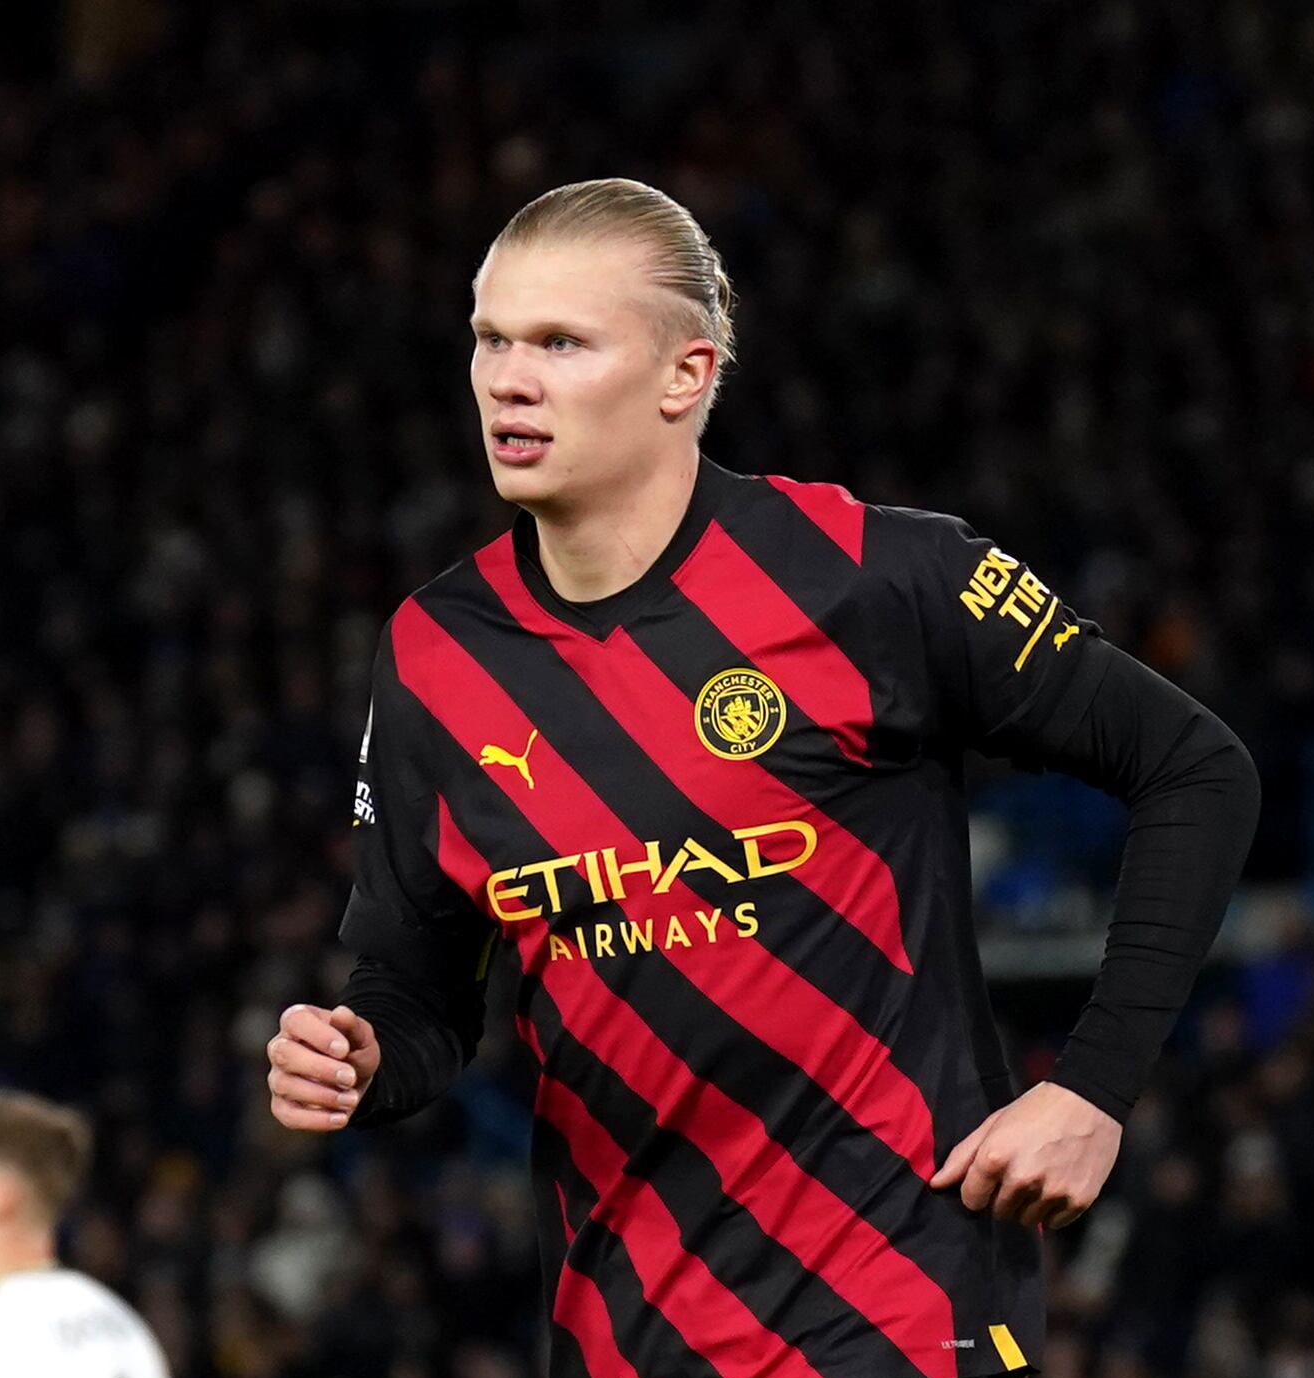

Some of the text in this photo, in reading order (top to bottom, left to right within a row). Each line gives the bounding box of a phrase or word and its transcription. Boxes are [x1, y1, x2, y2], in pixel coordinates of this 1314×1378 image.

[959, 548, 1020, 621] NEX
[998, 569, 1051, 628] TIR
[703, 675, 774, 709] MANCHESTER
[730, 741, 756, 754] CITY
[486, 820, 818, 922] ETIHAD
[550, 902, 759, 961] AIRWAYS
